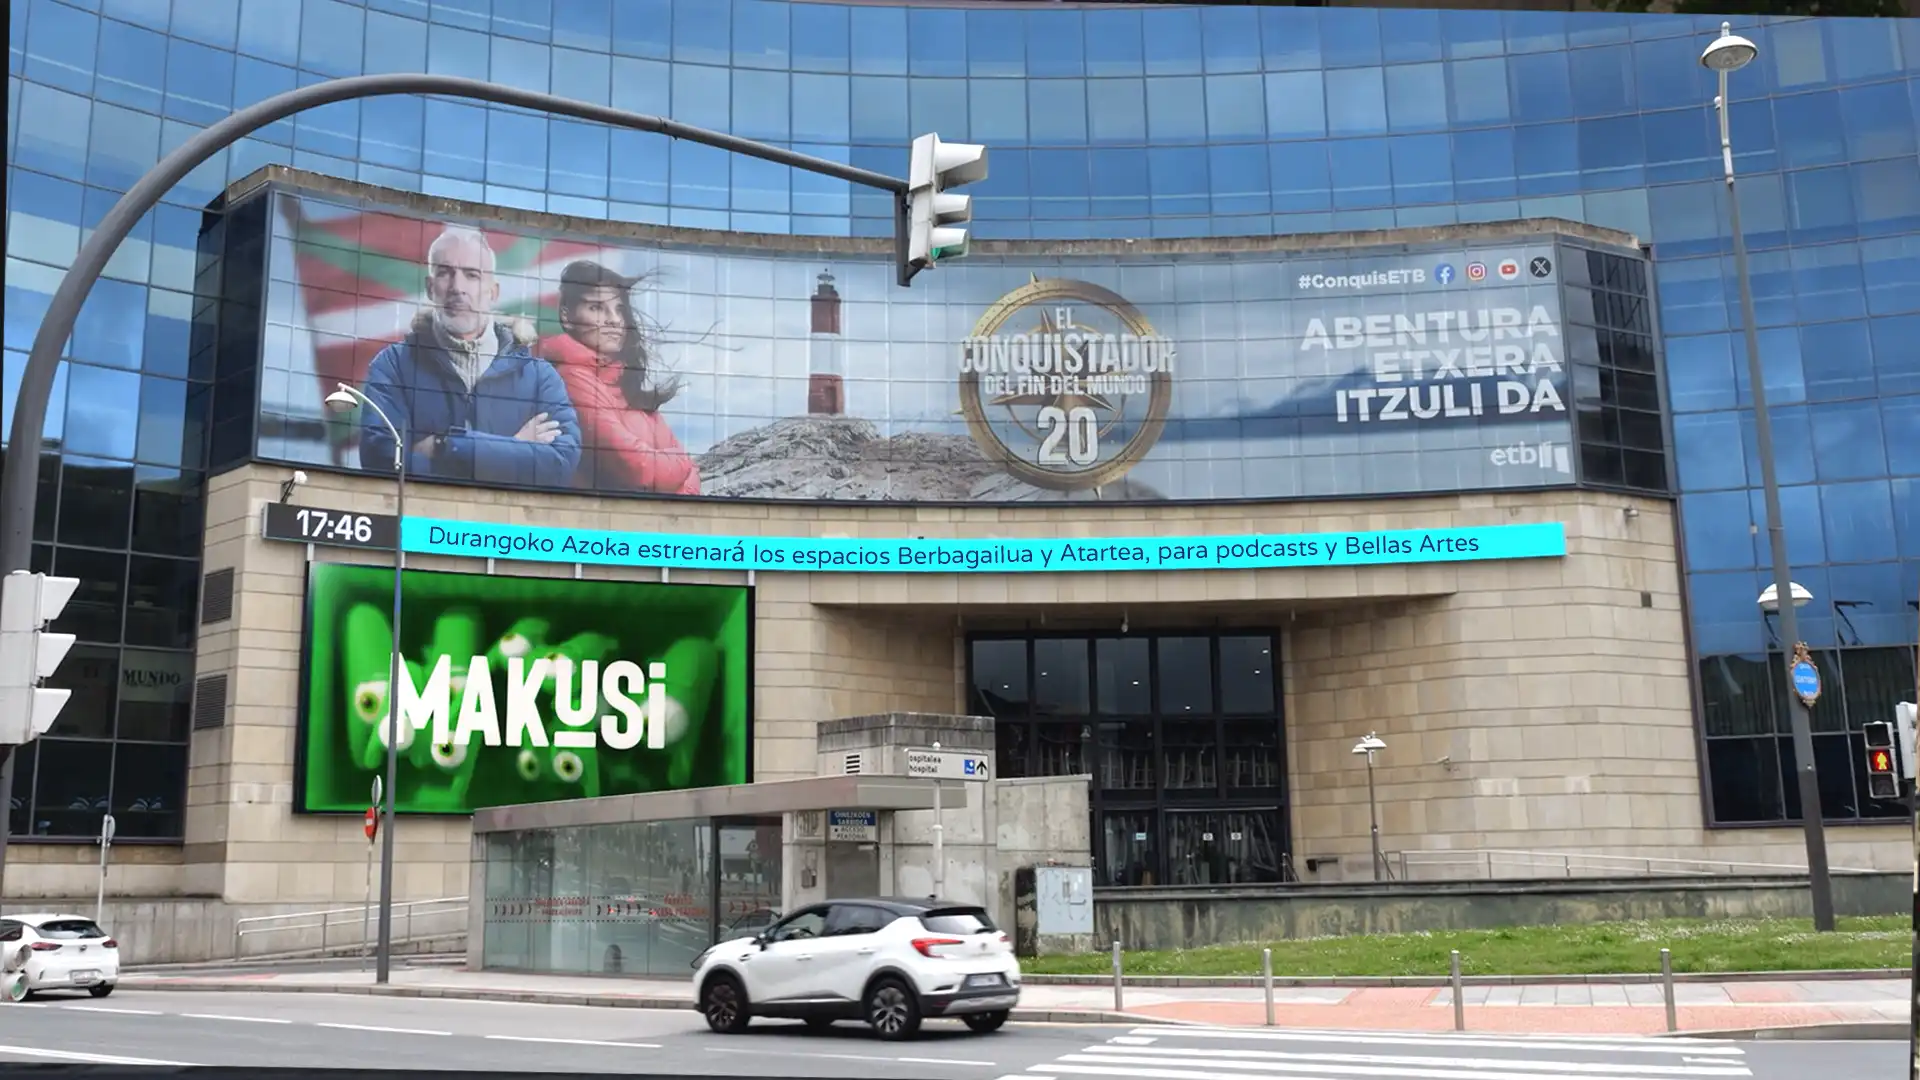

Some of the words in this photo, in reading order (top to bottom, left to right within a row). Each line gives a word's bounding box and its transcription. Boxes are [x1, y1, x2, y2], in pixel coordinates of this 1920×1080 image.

[1299, 269, 1426, 290] #ConquisETB
[1056, 307, 1076, 330] EL
[1300, 305, 1558, 350] ABENTURA
[958, 333, 1176, 374] CONQUISTADOR
[1374, 343, 1562, 382] ETXERA
[984, 375, 1014, 395] DEL
[1018, 375, 1046, 395] FIN
[1051, 375, 1085, 395] DEL
[1087, 374, 1146, 395] MUNDO
[1336, 382, 1483, 422] ITZULI
[1497, 379, 1566, 414] DA
[1036, 405, 1099, 467] 20
[296, 510, 372, 542] 17:46
[429, 526, 553, 555] Durangoko
[561, 535, 629, 556] Azoka
[637, 540, 744, 561] estrenará
[754, 544, 785, 562] los
[792, 547, 890, 568] espacios
[898, 545, 1032, 569] Berbagailua
[1040, 550, 1052, 568] y
[1060, 543, 1149, 563] Atartea,
[1158, 545, 1207, 564] para
[1216, 538, 1317, 563] podcasts
[1324, 541, 1337, 560] y
[1345, 535, 1412, 554] Bellas
[1419, 534, 1479, 553] Artes
[122, 669, 182, 687] MUNDO
